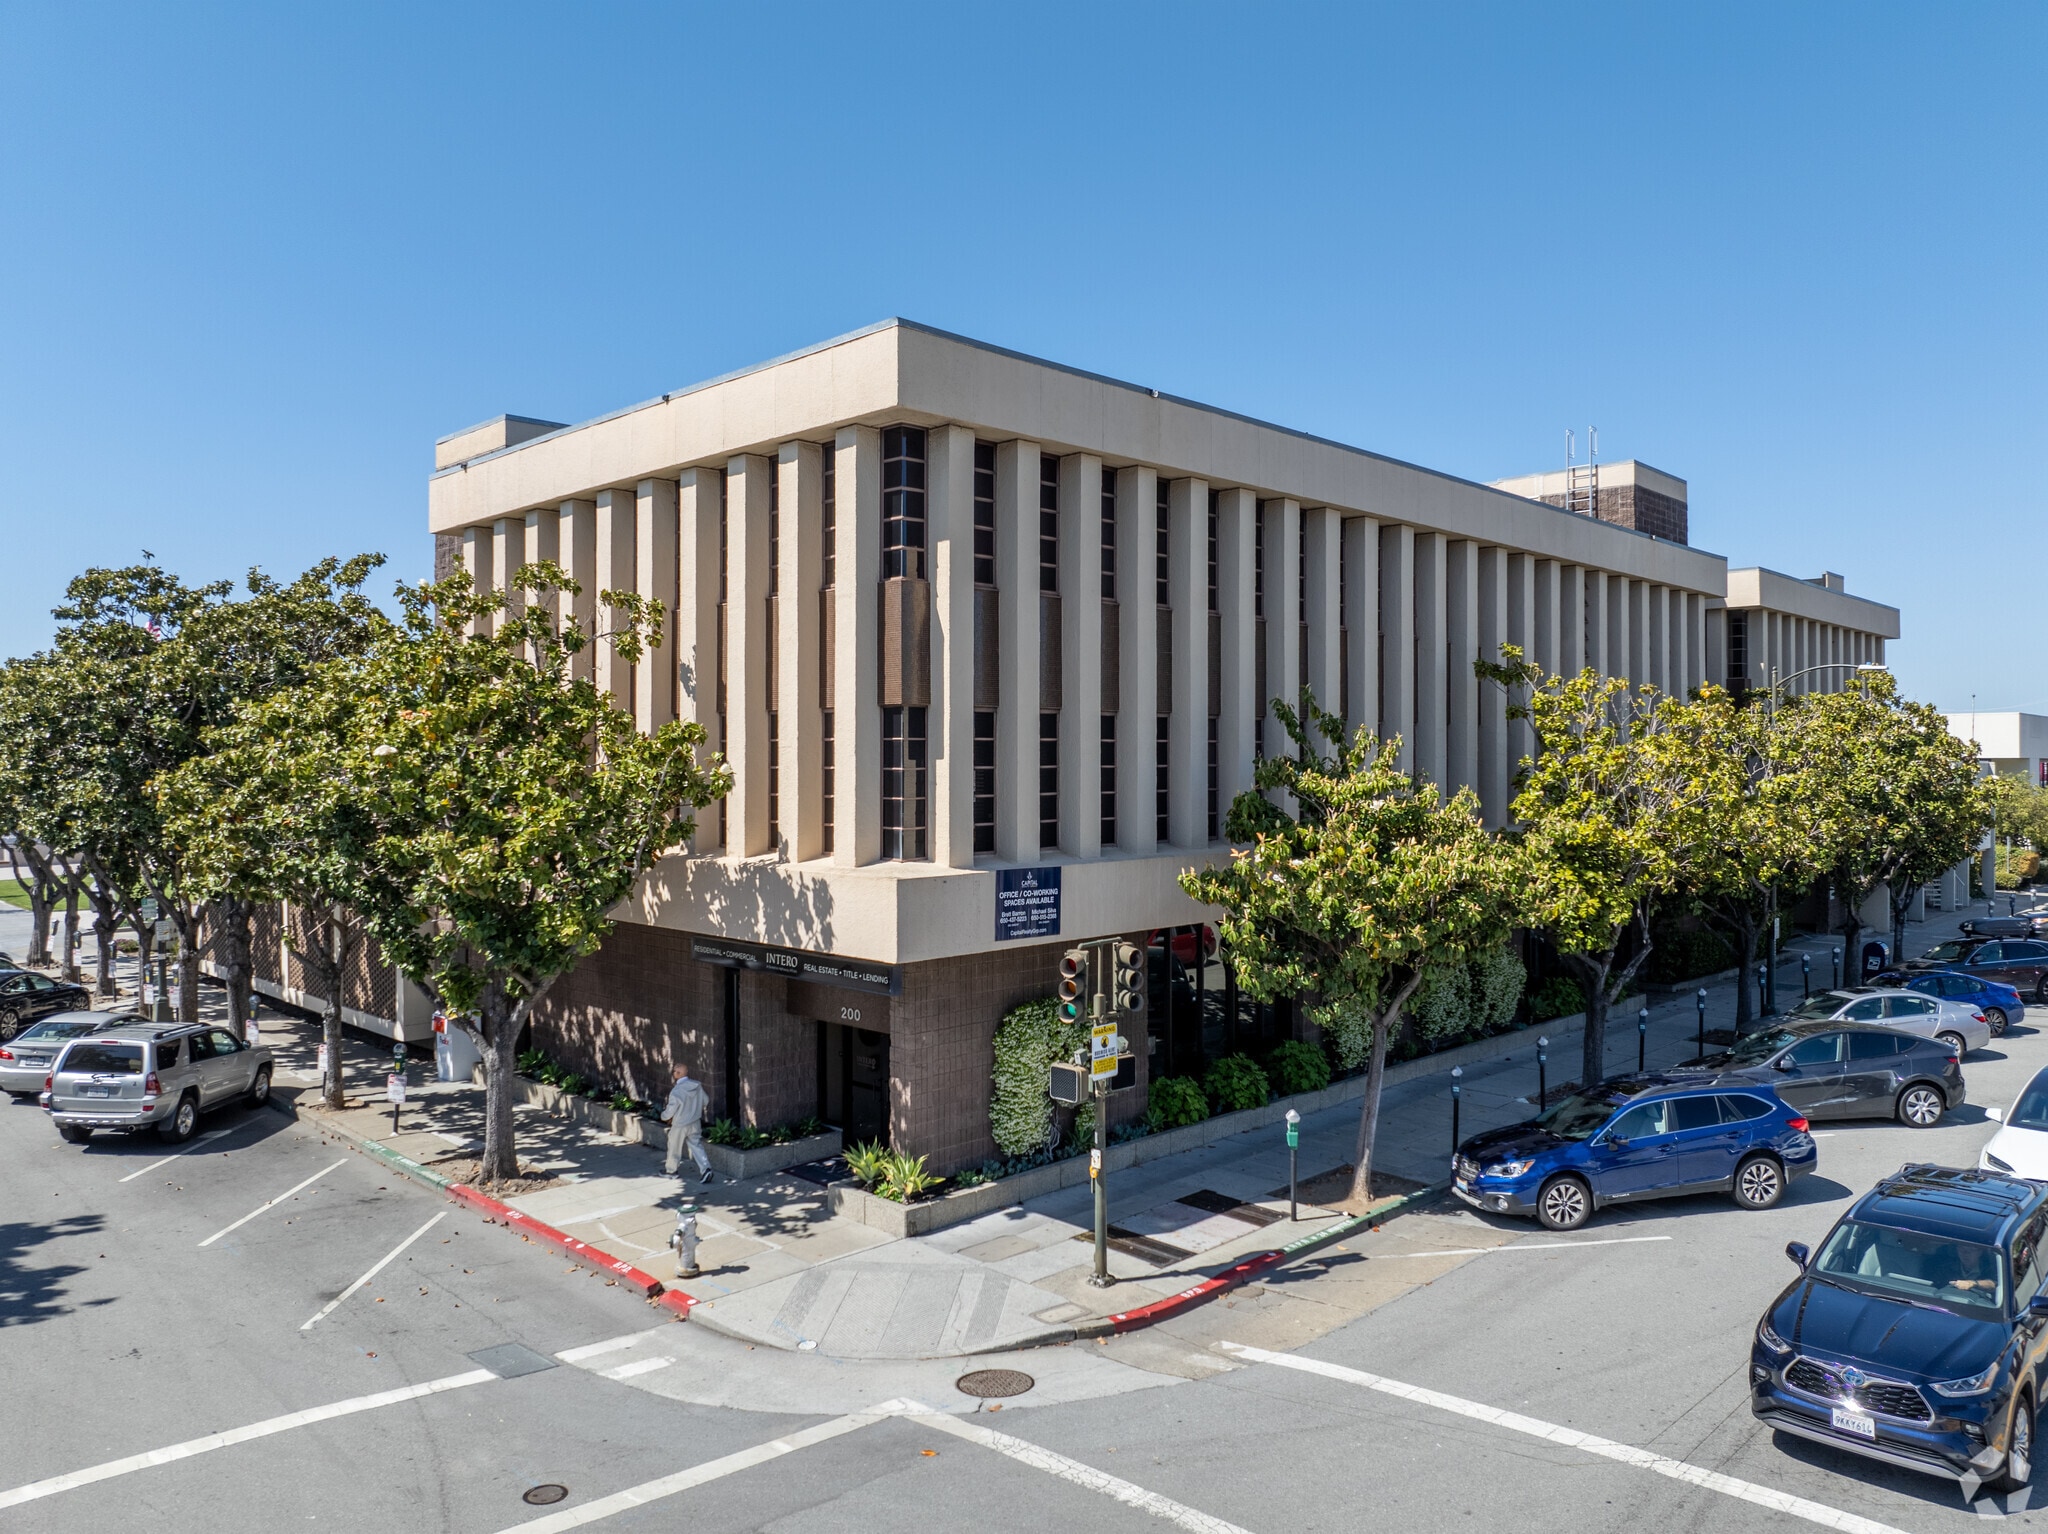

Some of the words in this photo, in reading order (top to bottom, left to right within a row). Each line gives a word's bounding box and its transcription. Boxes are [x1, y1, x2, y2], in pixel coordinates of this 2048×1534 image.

[999, 890, 1018, 899] OFFICE
[1023, 888, 1058, 898] CO-WORKING
[1004, 898, 1025, 907] SPACES
[1026, 896, 1054, 905] AVAILABLE
[694, 944, 722, 956] RESIDENTIAL
[726, 950, 757, 962] COMMERCIAL
[766, 952, 798, 968] INTERO
[804, 964, 818, 972] REAL
[818, 966, 838, 976] ESTATE
[843, 970, 858, 980] TITLE
[862, 974, 889, 984] LENDING
[841, 1006, 860, 1022] 200
[1094, 1026, 1115, 1034] WARNING
